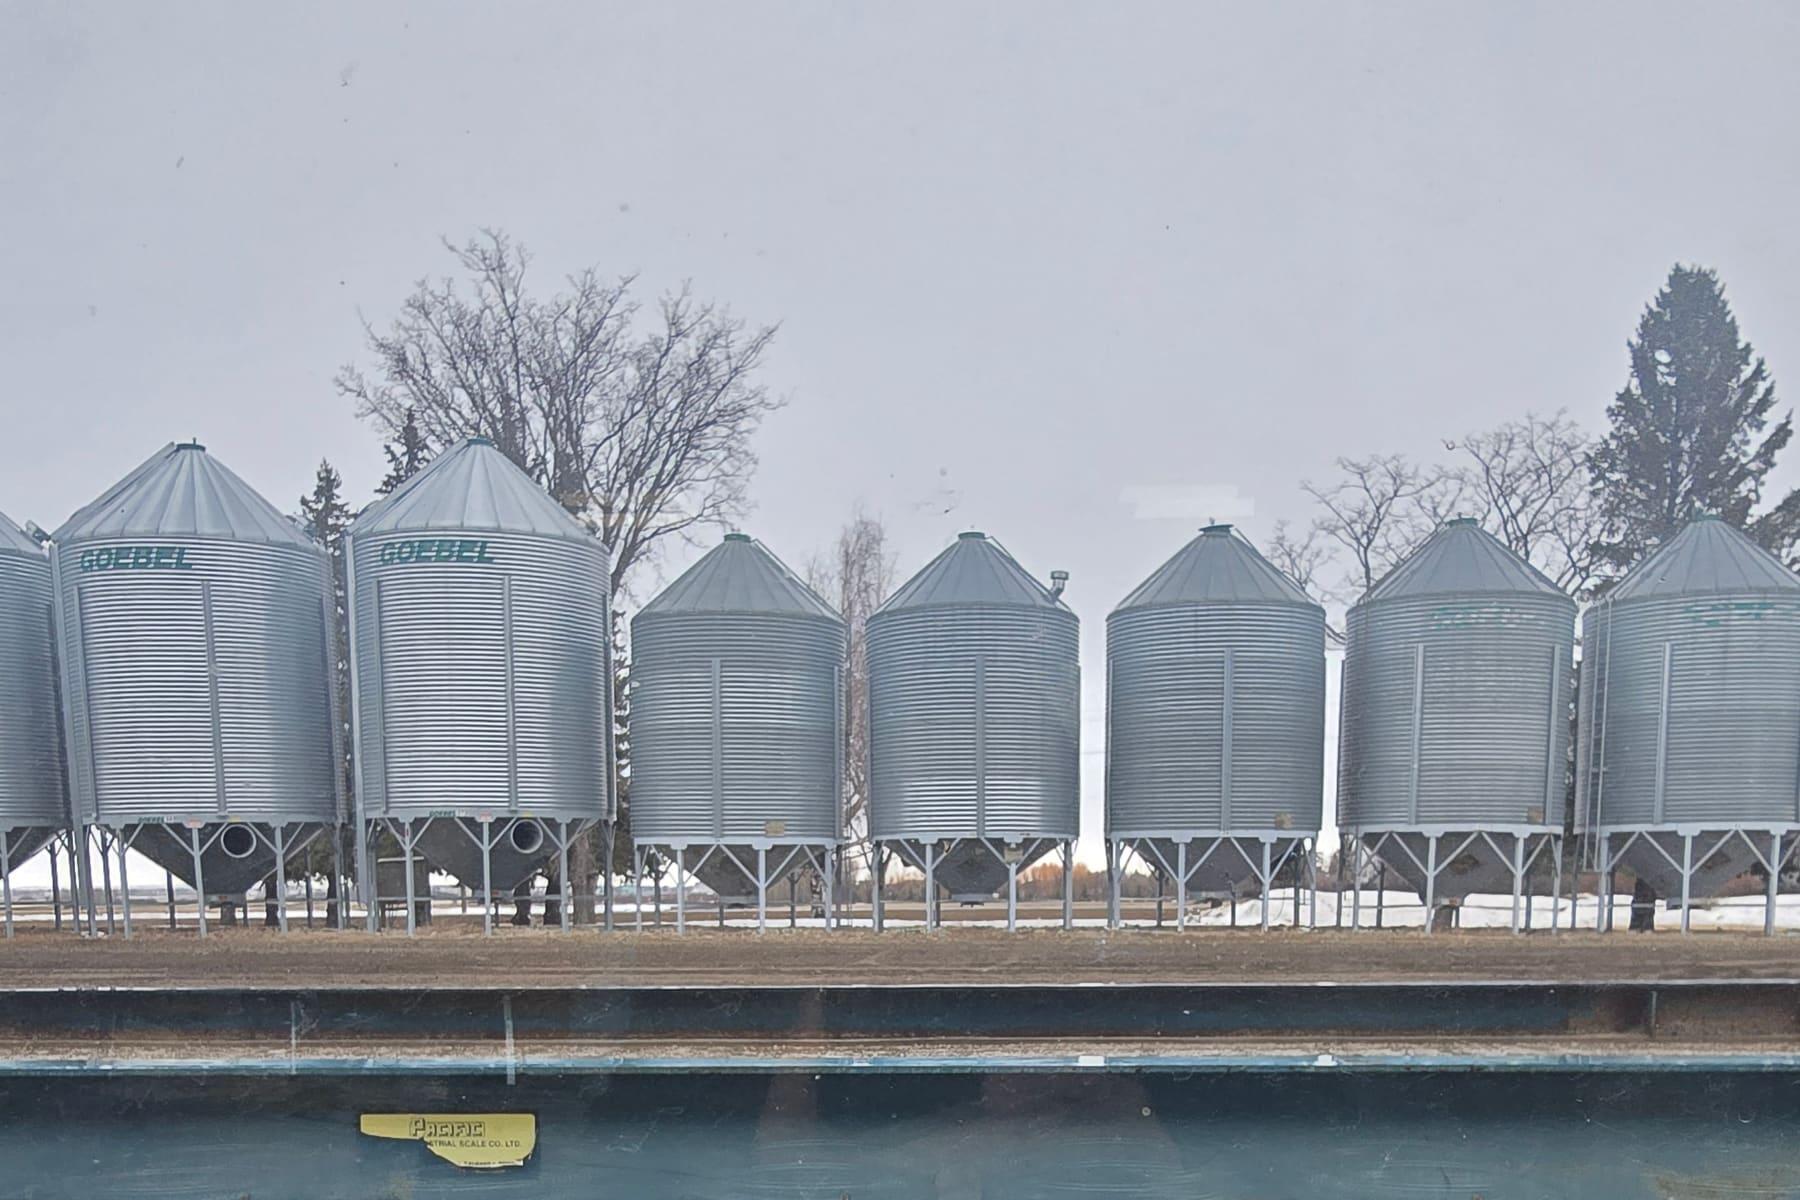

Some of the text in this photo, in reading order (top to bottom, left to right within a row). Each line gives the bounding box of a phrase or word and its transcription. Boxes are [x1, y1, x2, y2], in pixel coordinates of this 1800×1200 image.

[80, 546, 193, 571] GOEBEL
[380, 540, 496, 564] GOEBEL
[459, 1139, 486, 1148] SCALE
